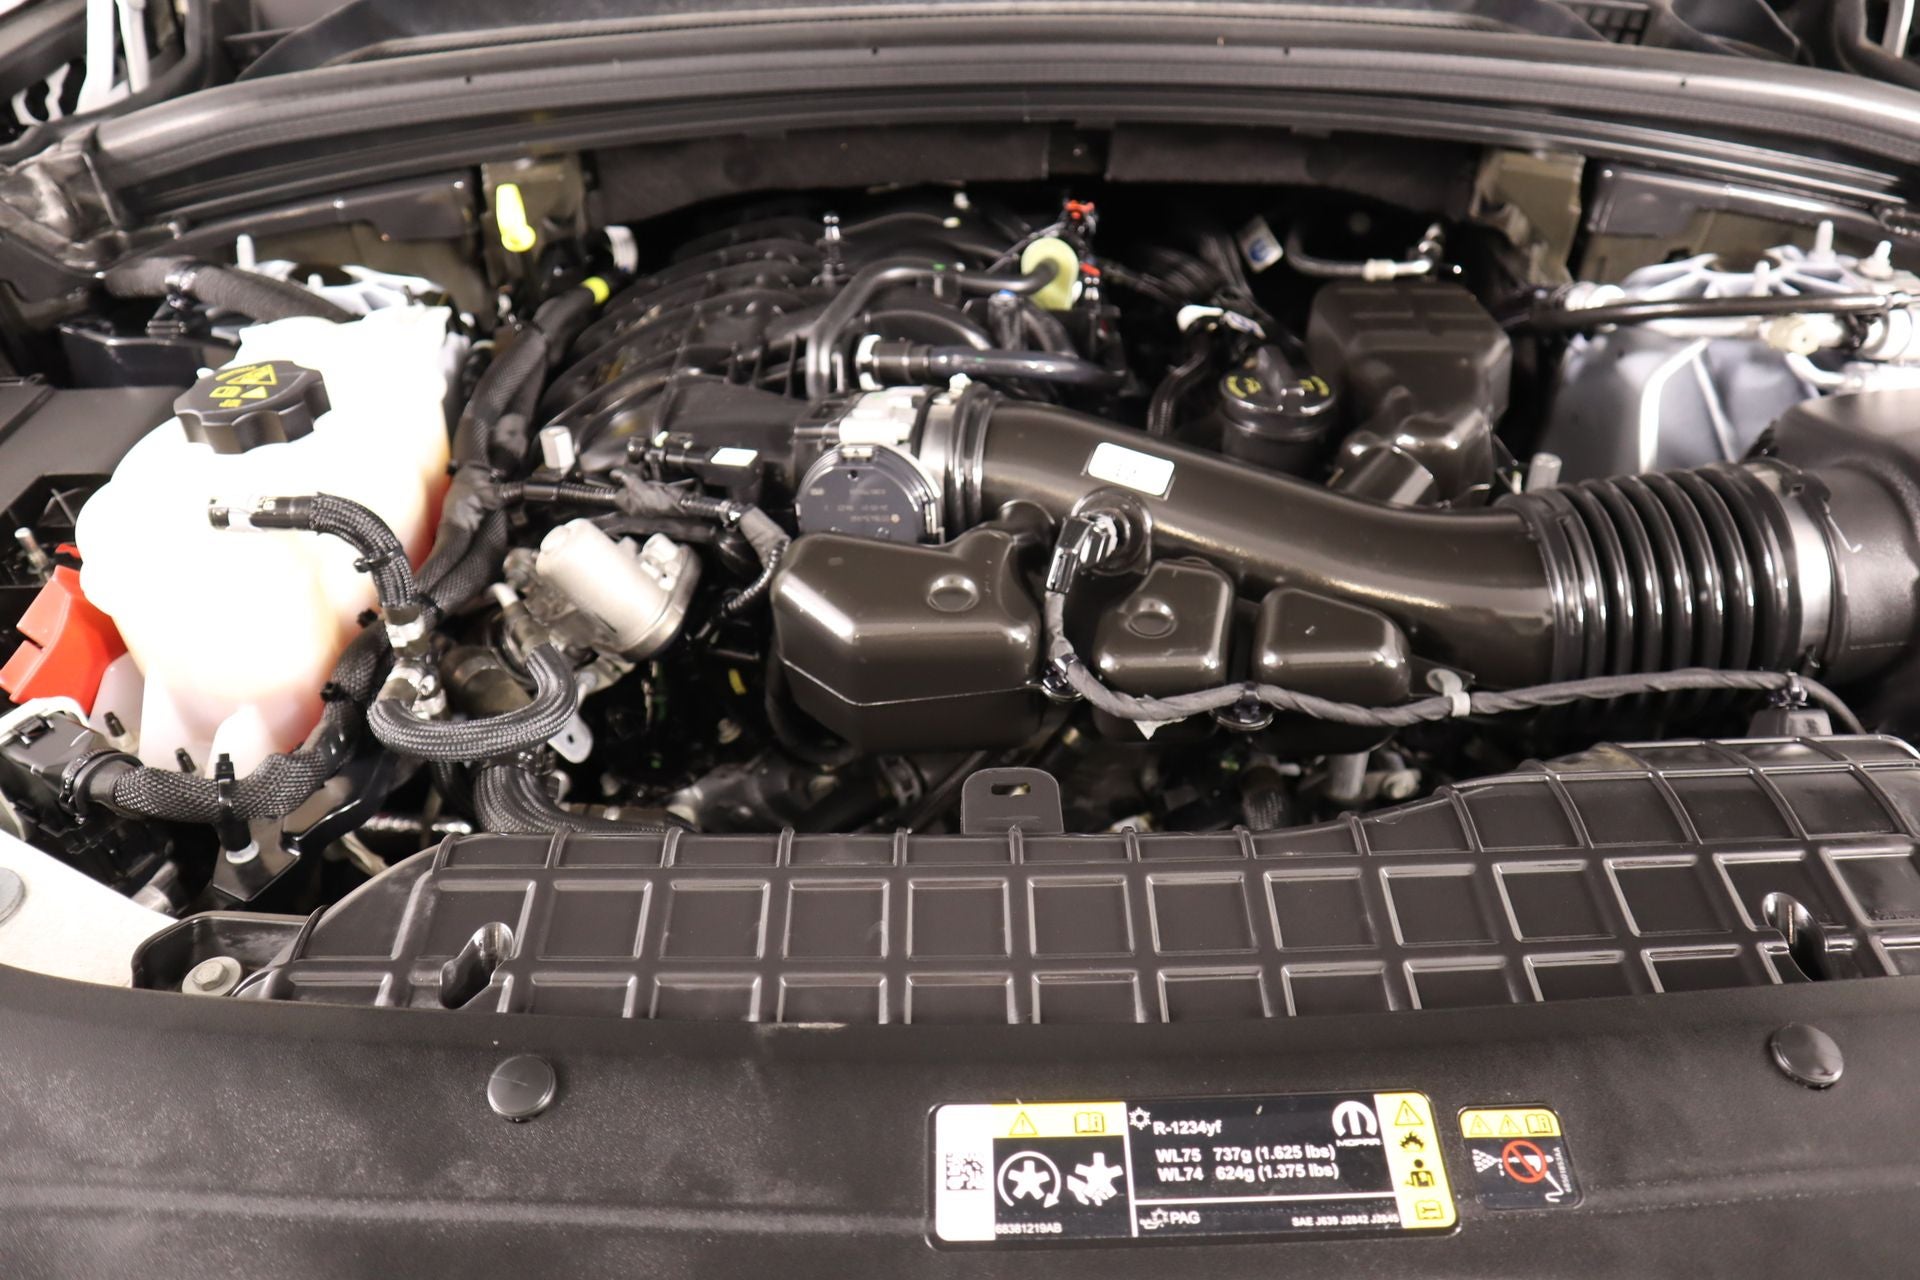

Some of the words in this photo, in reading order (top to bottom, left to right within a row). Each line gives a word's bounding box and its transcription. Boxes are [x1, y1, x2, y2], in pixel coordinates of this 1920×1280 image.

[1153, 1120, 1222, 1138] R-1234yf
[1155, 1148, 1201, 1163] WL75
[1213, 1147, 1252, 1164] 737g
[1255, 1145, 1303, 1161] (1.625
[1306, 1143, 1336, 1160] lbs)
[1157, 1166, 1204, 1182] WL74
[1215, 1165, 1255, 1183] 624g
[1258, 1164, 1306, 1181] (1.375
[1309, 1162, 1339, 1180] lbs)
[1170, 1210, 1200, 1225] PAG
[1291, 1216, 1314, 1227] SAE
[995, 1221, 1063, 1235] 68381219AB
